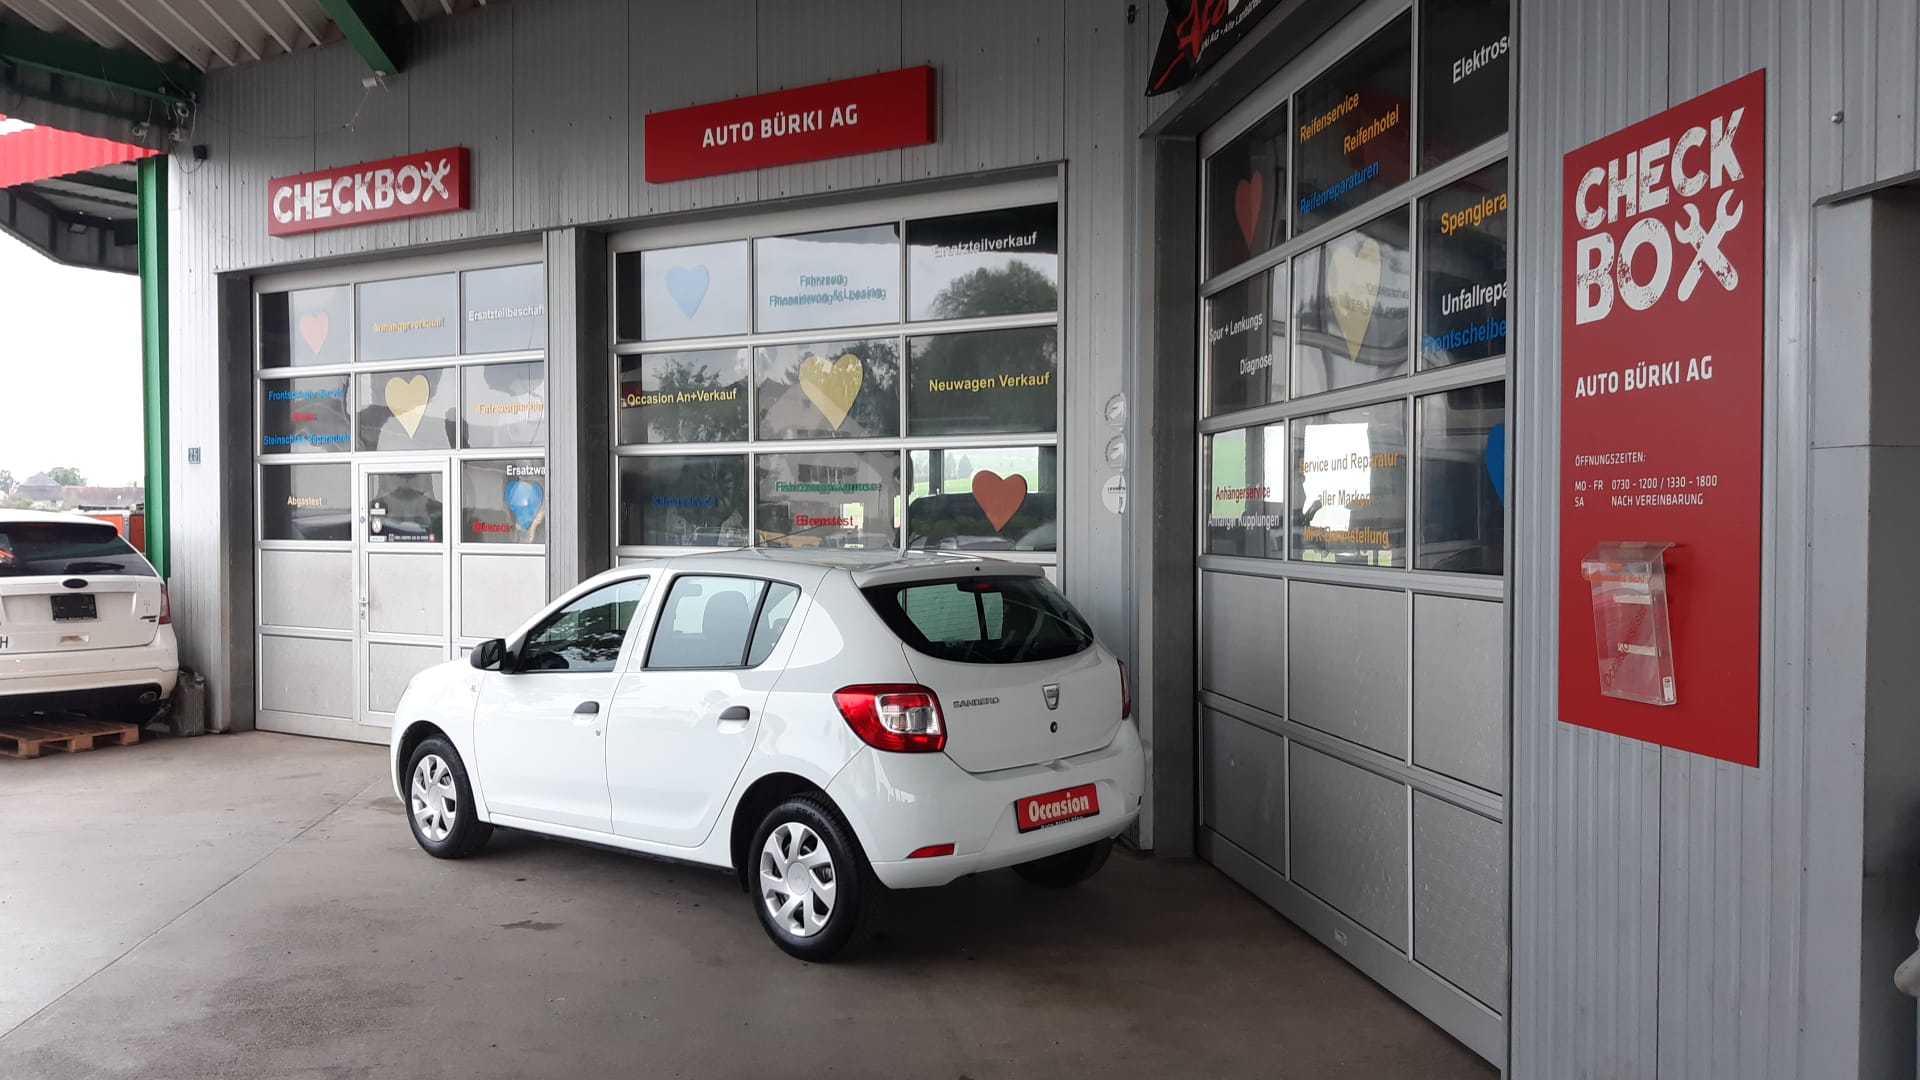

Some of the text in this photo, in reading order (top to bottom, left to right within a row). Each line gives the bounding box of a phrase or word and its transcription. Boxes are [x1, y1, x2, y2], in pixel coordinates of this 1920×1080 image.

[701, 103, 858, 149] AUTO BÜRKI AG
[1300, 91, 1359, 145] Reifenservice
[1343, 104, 1399, 156] Reifenhotel
[1575, 106, 1746, 231] CHECK
[273, 157, 451, 224] CHECKBOX
[1300, 160, 1380, 217] Reifenreparaturen
[1440, 192, 1508, 237] Spenglera
[933, 231, 1038, 259] Ersatzteilverkauf
[1575, 188, 1745, 326] BOX
[1441, 281, 1508, 316] Unfallrepa
[1208, 327, 1224, 345] Spur
[1229, 313, 1263, 336] Lenkungs
[1240, 353, 1273, 376] Diagnose
[1575, 355, 1713, 399] AUTO BÜRKI AG
[928, 371, 1050, 393] Neuwagen Verkauf
[627, 387, 738, 406] Occasion An+Verkauf
[505, 464, 545, 477] Ersatzwa
[1299, 450, 1399, 474] Service und Reparatur
[1574, 451, 1646, 467] ÖFFNUNGSZEITEN:
[1215, 485, 1271, 503] Anhängerservice
[1574, 480, 1587, 491] MO
[1593, 480, 1603, 491] FR
[1611, 478, 1630, 490] 0730
[1638, 478, 1658, 489] 1200
[1666, 476, 1686, 488] 1330
[1695, 475, 1718, 487] 1800
[1317, 489, 1373, 507] aller Marken
[1574, 493, 1704, 507] SA NACH VEREINBARUNG
[1238, 511, 1280, 531] Kupplungen
[952, 696, 1000, 709] SANDERO
[1028, 791, 1089, 823] Occasion
